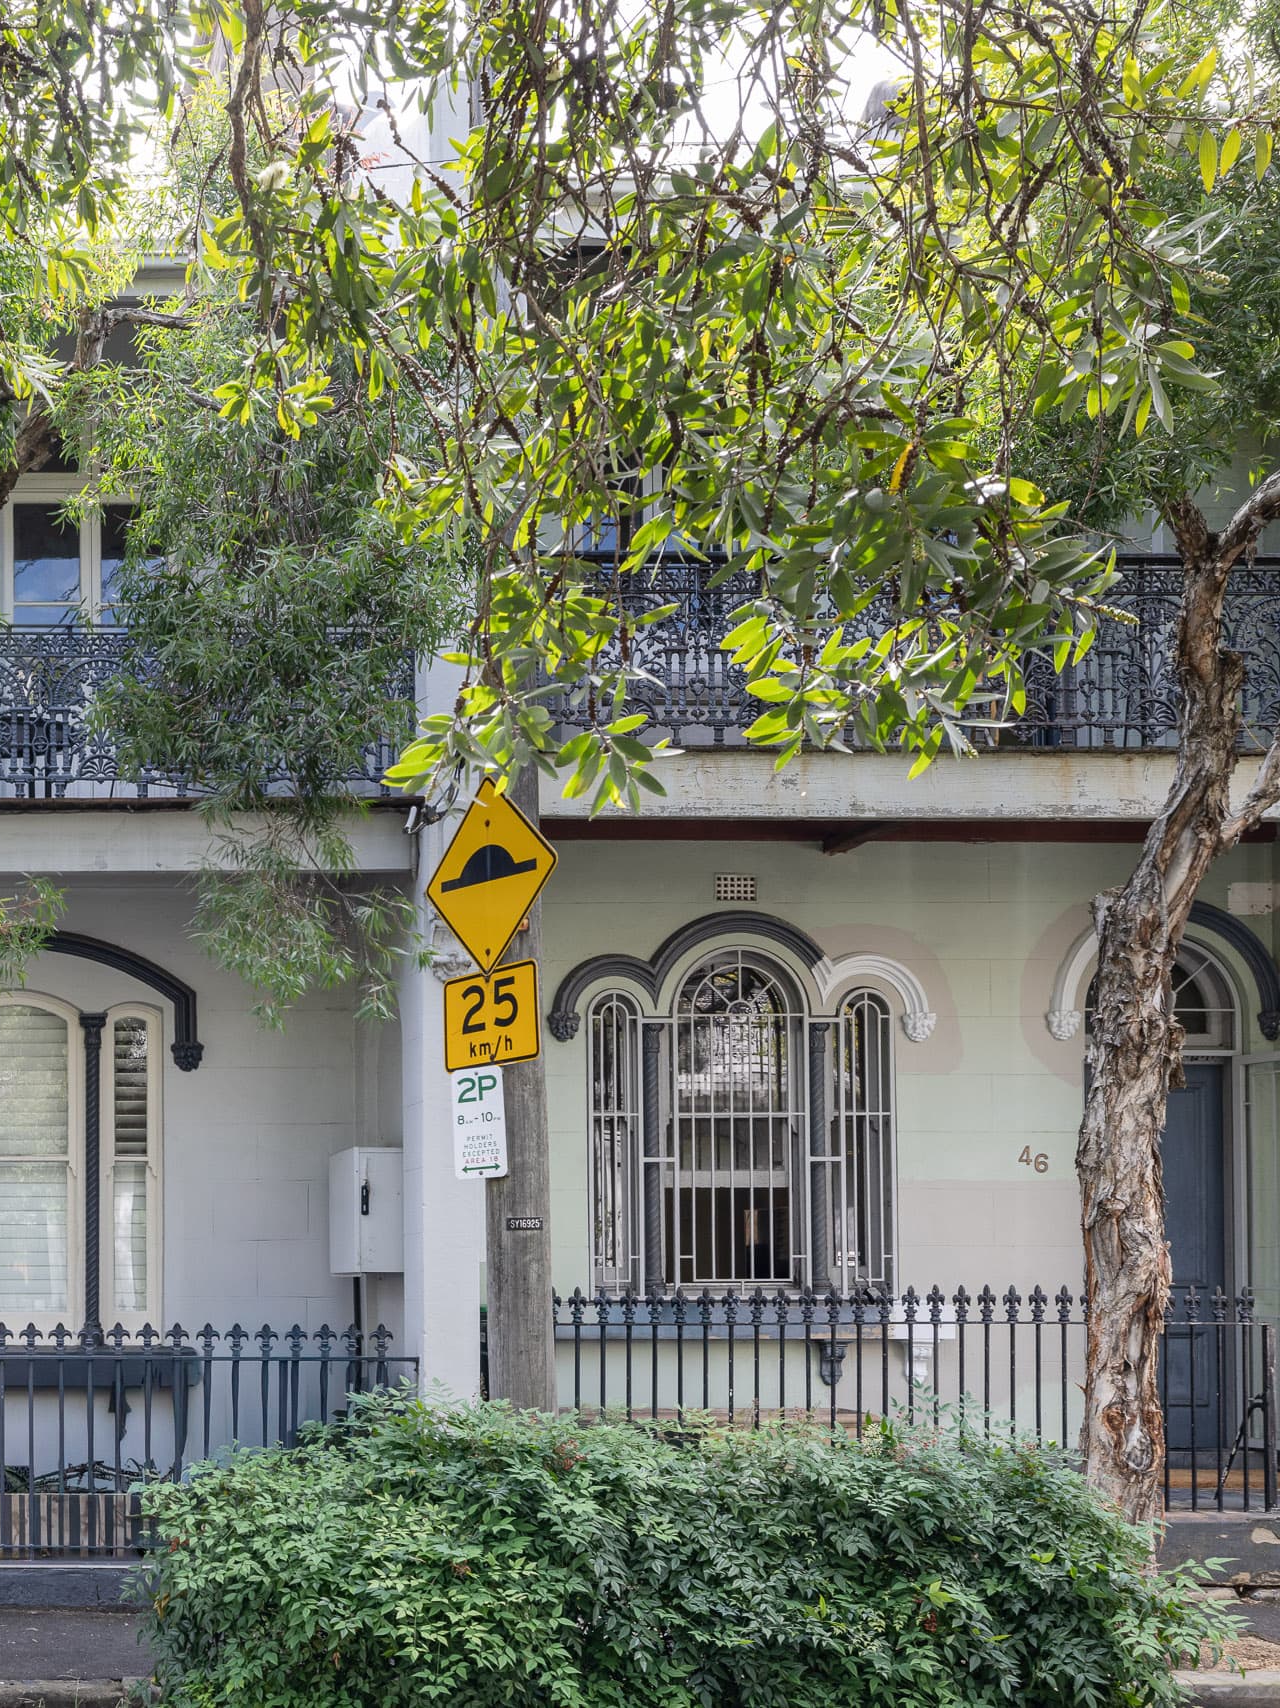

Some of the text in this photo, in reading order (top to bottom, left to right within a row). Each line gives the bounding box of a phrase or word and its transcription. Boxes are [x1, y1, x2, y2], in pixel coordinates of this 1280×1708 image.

[462, 976, 518, 1035] 25
[470, 1034, 513, 1059] km/h
[457, 1075, 497, 1103] 2P
[466, 1133, 493, 1142] PERMIT
[464, 1141, 497, 1150] HOLDERS
[462, 1149, 501, 1158] EXCEPTED
[465, 1157, 486, 1165] AREA
[1018, 1145, 1049, 1174] 46
[510, 1219, 540, 1229] SY16925
